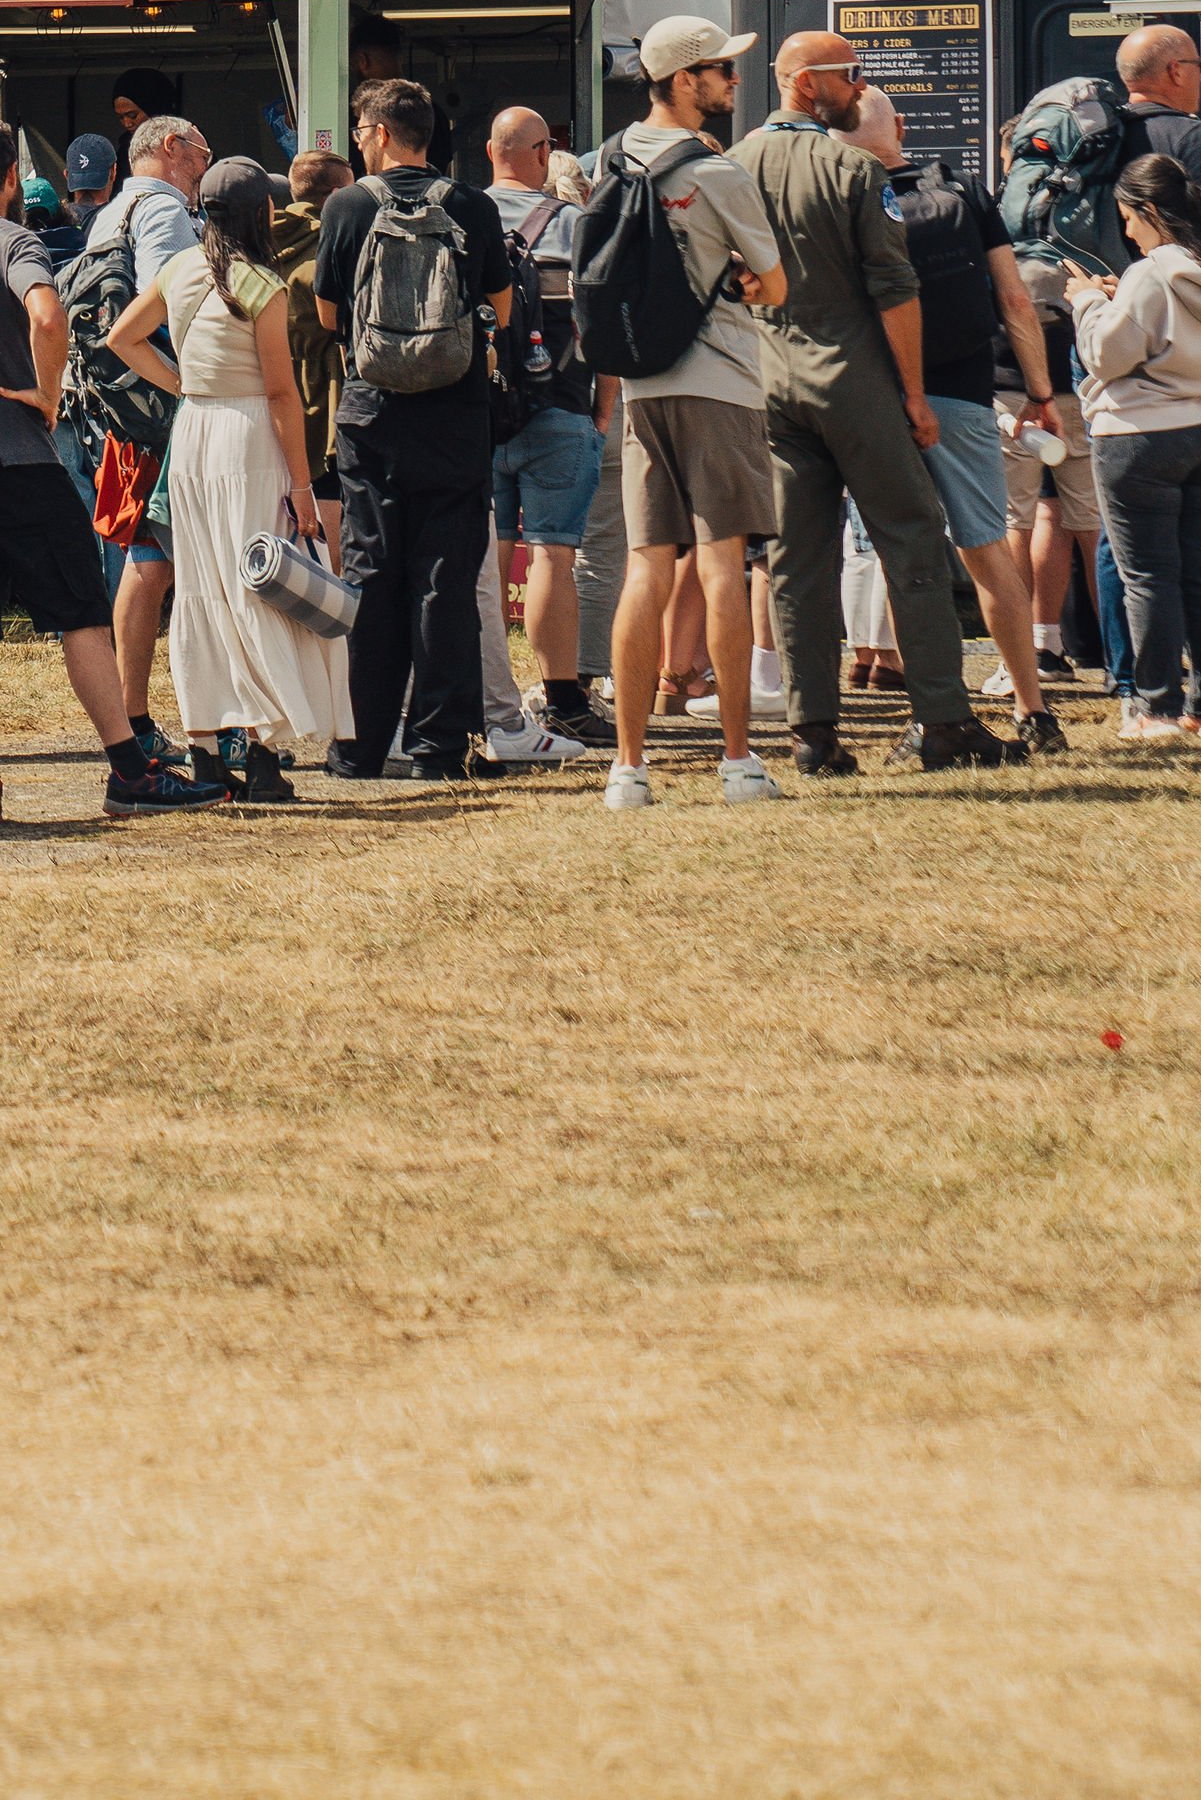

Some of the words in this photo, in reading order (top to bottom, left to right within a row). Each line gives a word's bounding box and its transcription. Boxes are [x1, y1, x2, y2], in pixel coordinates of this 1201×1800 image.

[845, 10, 915, 28] DRINKS
[927, 8, 975, 26] MENU
[883, 38, 912, 48] CIDER
[883, 82, 934, 93] COCKTAILS
